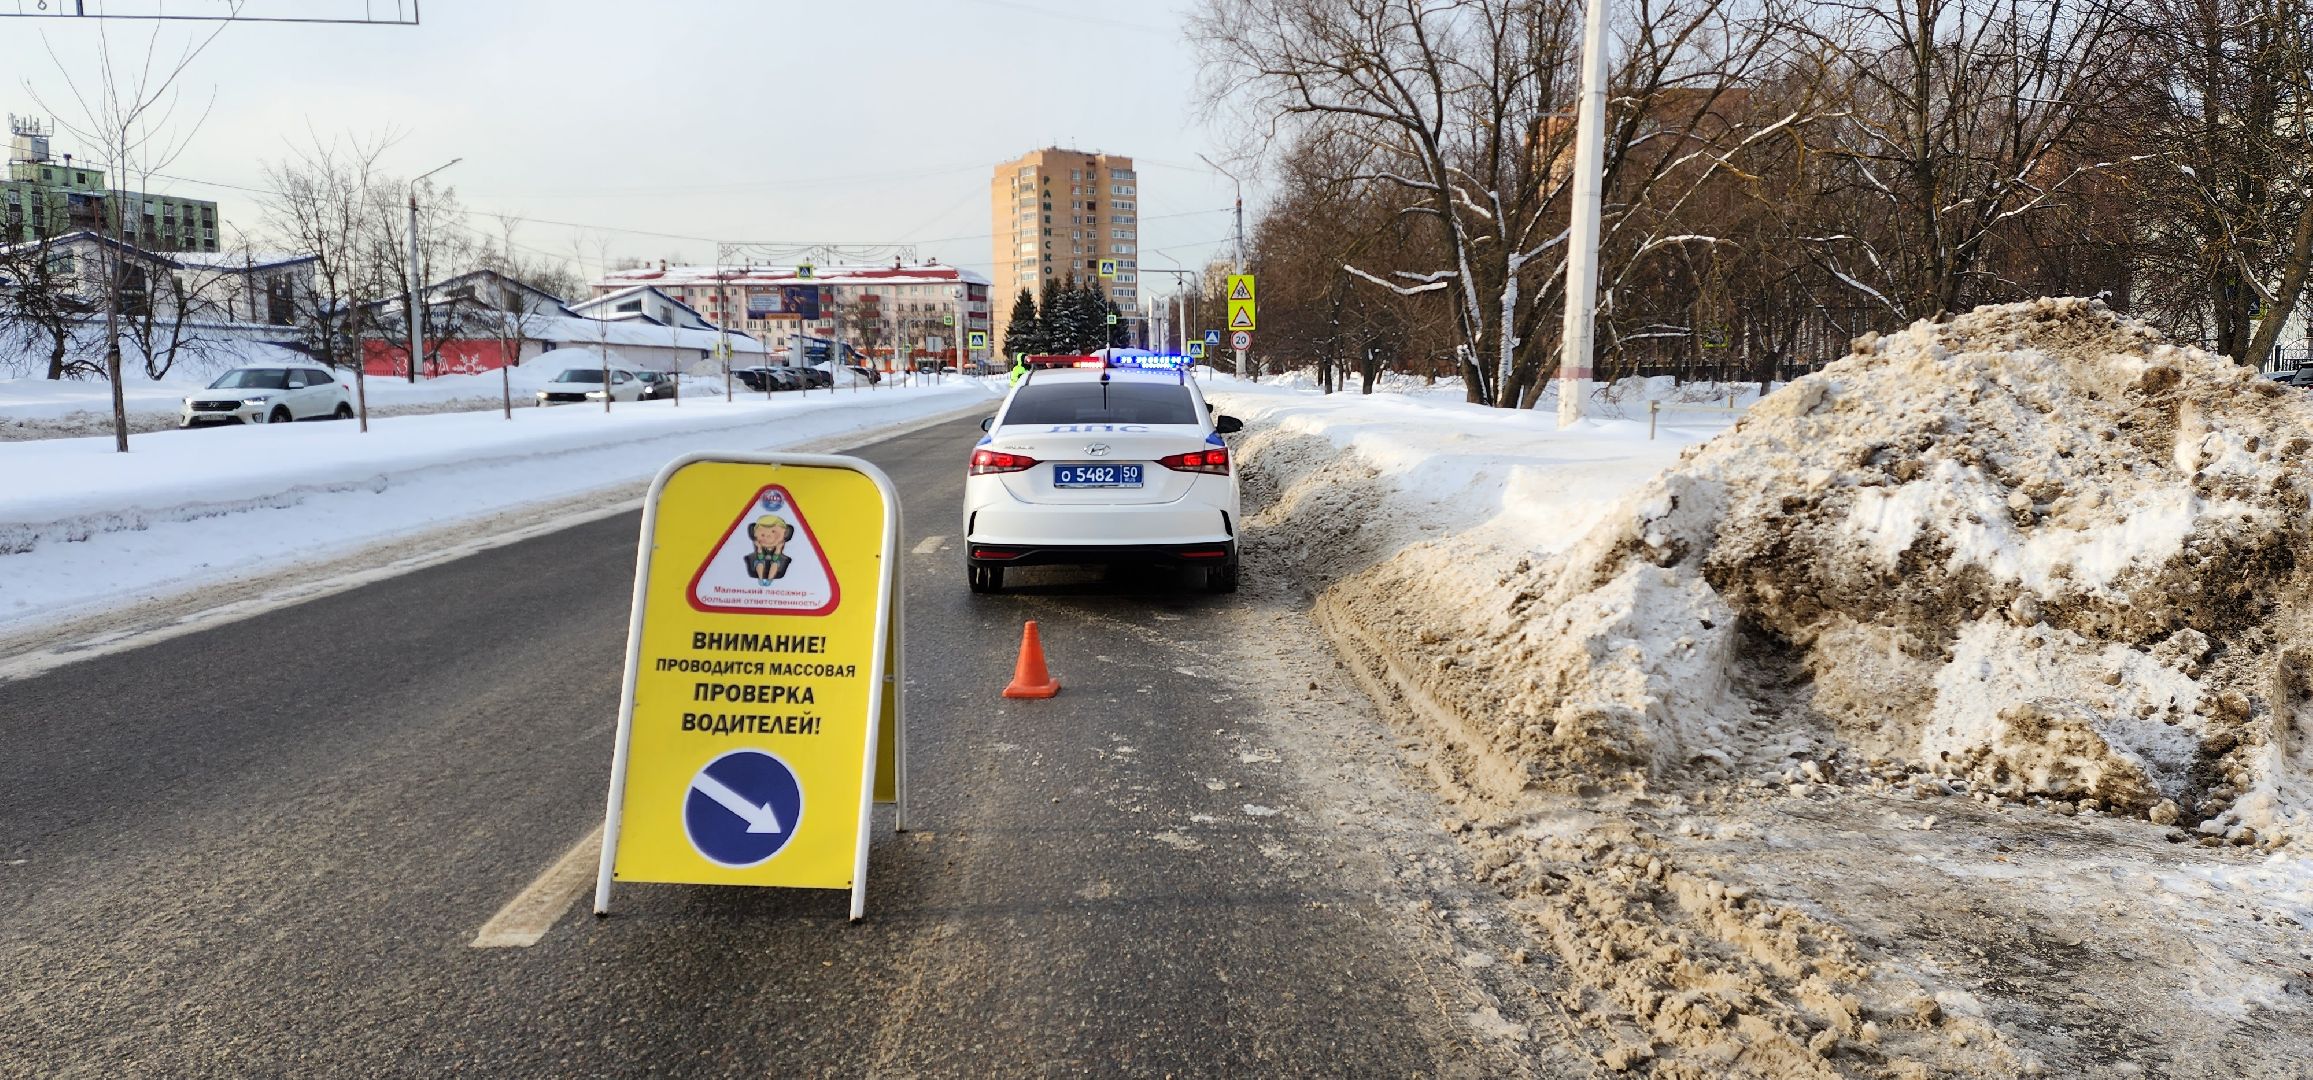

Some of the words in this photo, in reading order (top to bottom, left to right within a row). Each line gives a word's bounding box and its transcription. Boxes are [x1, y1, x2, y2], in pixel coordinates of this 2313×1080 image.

[1236, 336, 1246, 344] 20
[396, 356, 450, 376] ЗМА
[1047, 424, 1148, 434] ДПС
[1076, 467, 1114, 482] 5482
[1123, 466, 1138, 478] 50
[701, 596, 741, 604] большая
[713, 586, 763, 595] Маленький
[765, 588, 807, 597] пассажир
[692, 631, 826, 654] ВНИМАНИЕ!
[656, 658, 765, 676] ПРОВОДИТСЯ
[769, 663, 856, 678] МАССОВАЯ
[694, 683, 815, 705] ПРОВЕРКА
[681, 711, 821, 736] ВОДИТЕЛЕЙ!
